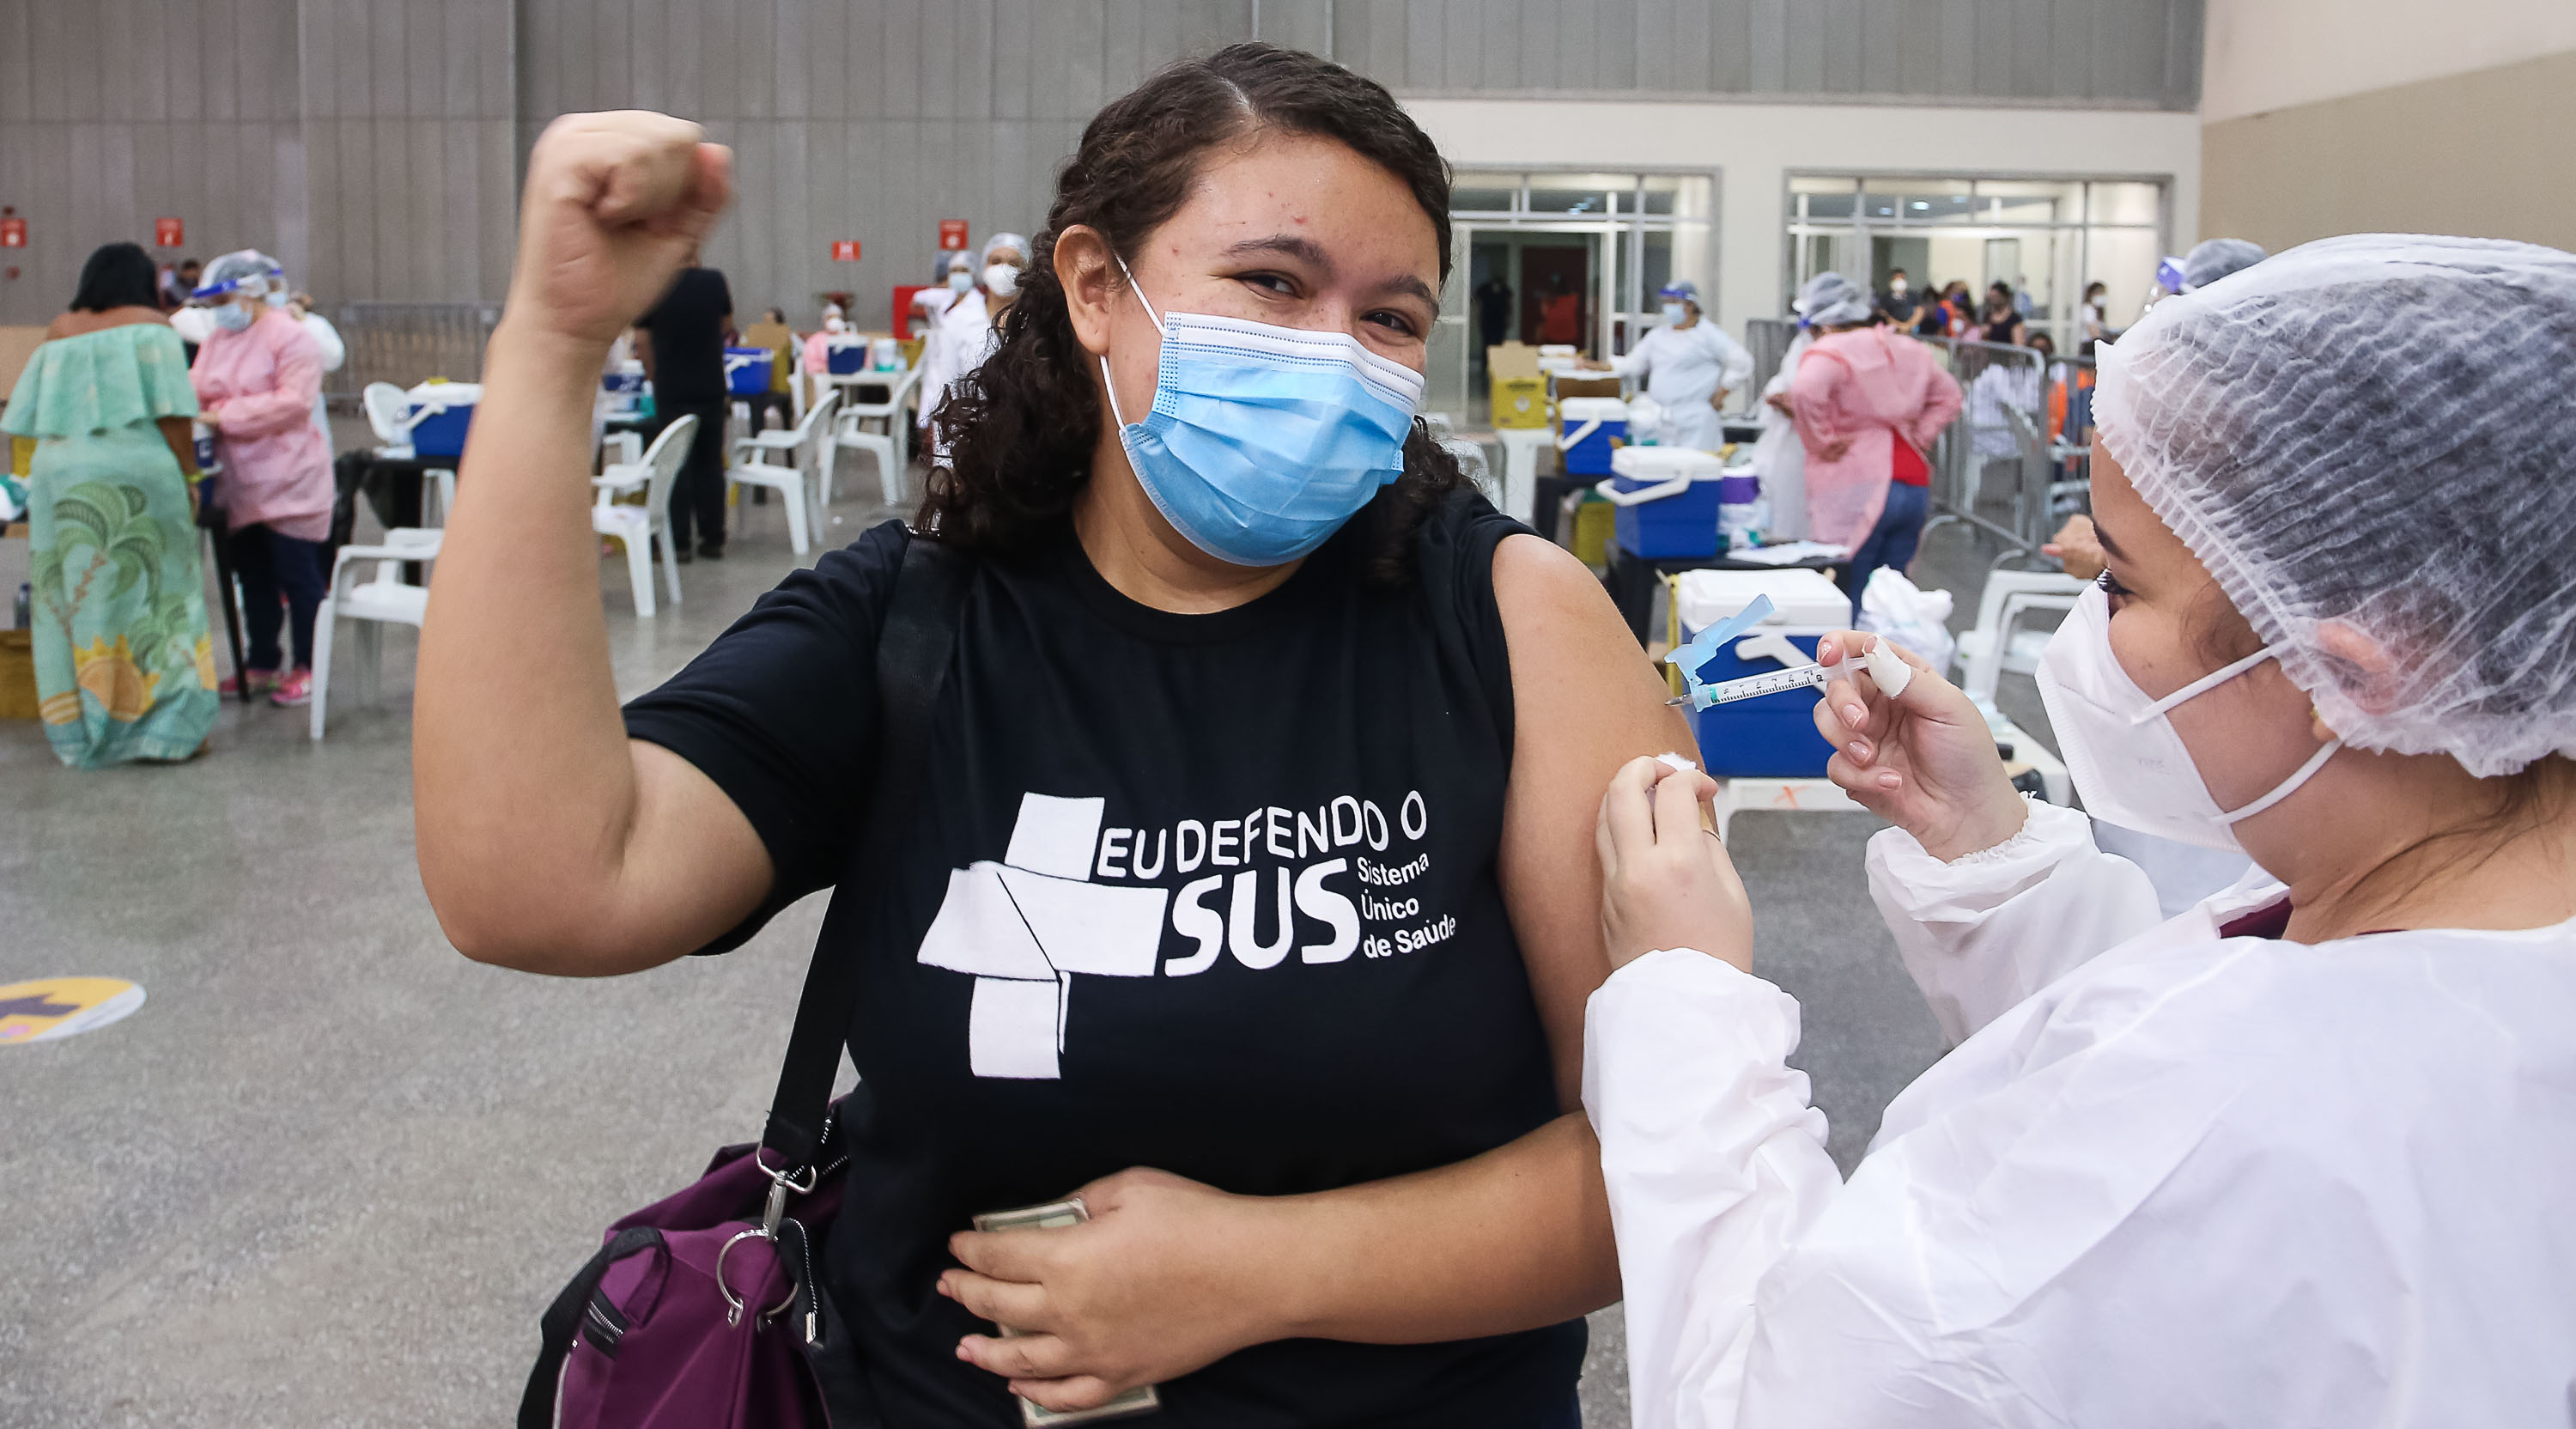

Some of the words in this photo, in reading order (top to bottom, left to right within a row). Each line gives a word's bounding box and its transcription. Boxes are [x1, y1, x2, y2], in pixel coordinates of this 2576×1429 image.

[1097, 827, 1167, 880] EU
[1176, 794, 1389, 873] DEFENDO
[1400, 789, 1427, 841] O
[1357, 853, 1430, 886] Sistema
[1163, 857, 1361, 977] SUS
[1360, 888, 1419, 921] Único
[1363, 933, 1393, 959] de
[1394, 913, 1456, 954] Saúde
